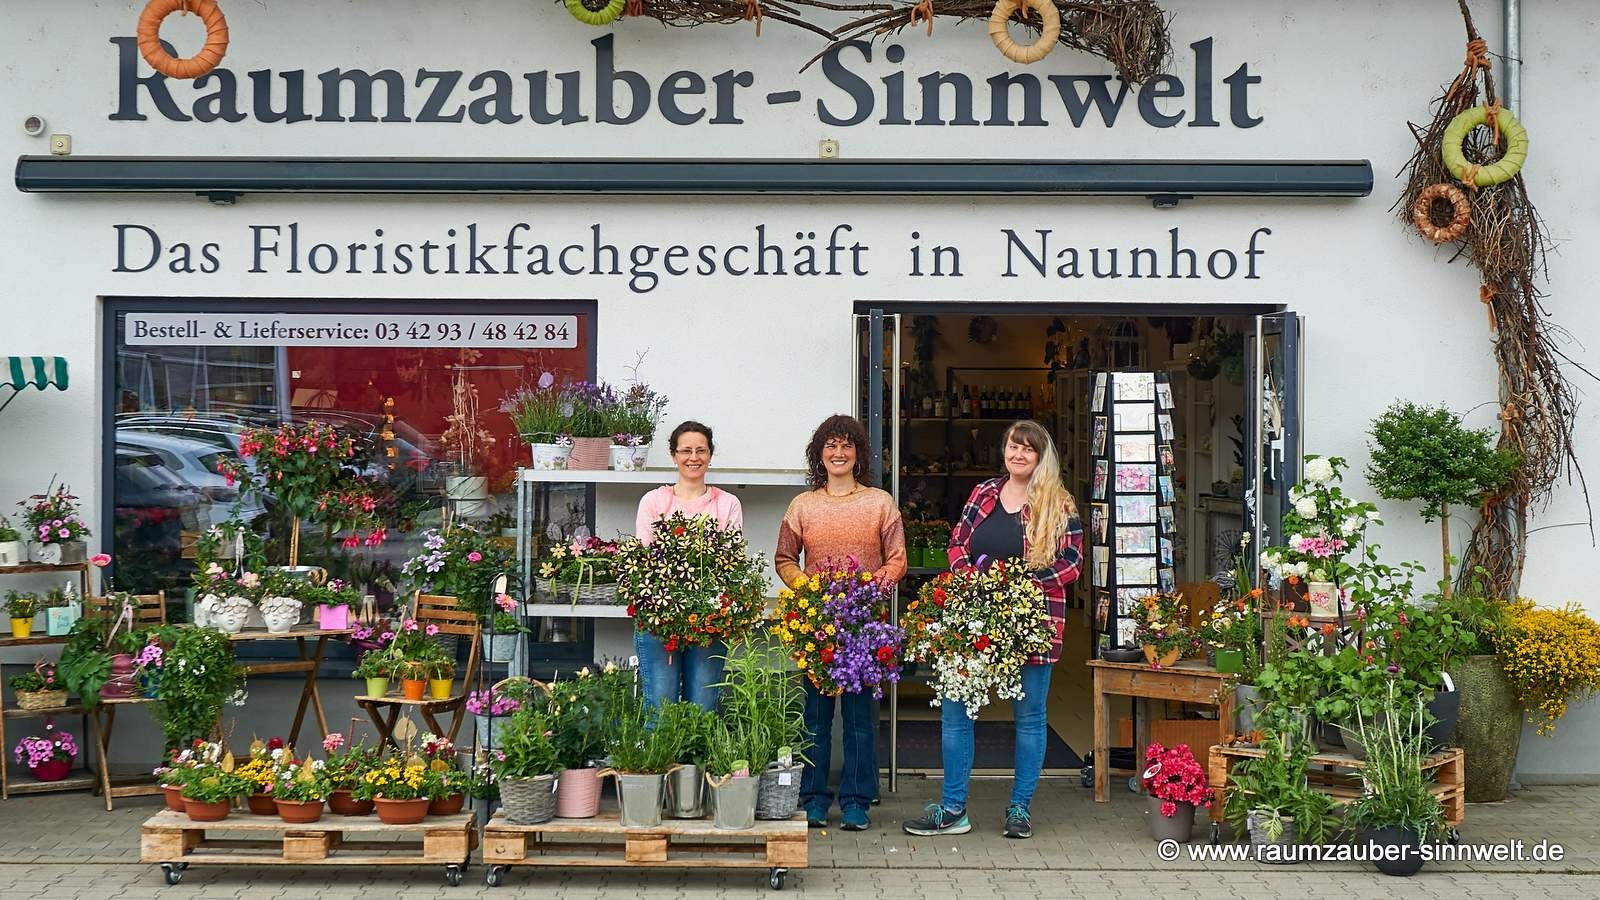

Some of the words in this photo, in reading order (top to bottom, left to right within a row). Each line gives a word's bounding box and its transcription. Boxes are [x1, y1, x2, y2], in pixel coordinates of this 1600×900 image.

[112, 224, 220, 275] Das
[248, 223, 869, 294] Floristikfachgeschäft
[909, 231, 963, 278] in
[1001, 227, 1273, 280] Naunhof
[134, 319, 207, 338] Bestell-
[213, 321, 233, 339] &
[239, 320, 369, 340] Lieferservice:
[375, 322, 400, 341] 03
[406, 321, 431, 340] 42
[437, 323, 462, 341] 93
[468, 322, 476, 341] /
[482, 321, 507, 341] 48
[513, 321, 538, 341] 42
[544, 321, 569, 341] 84
